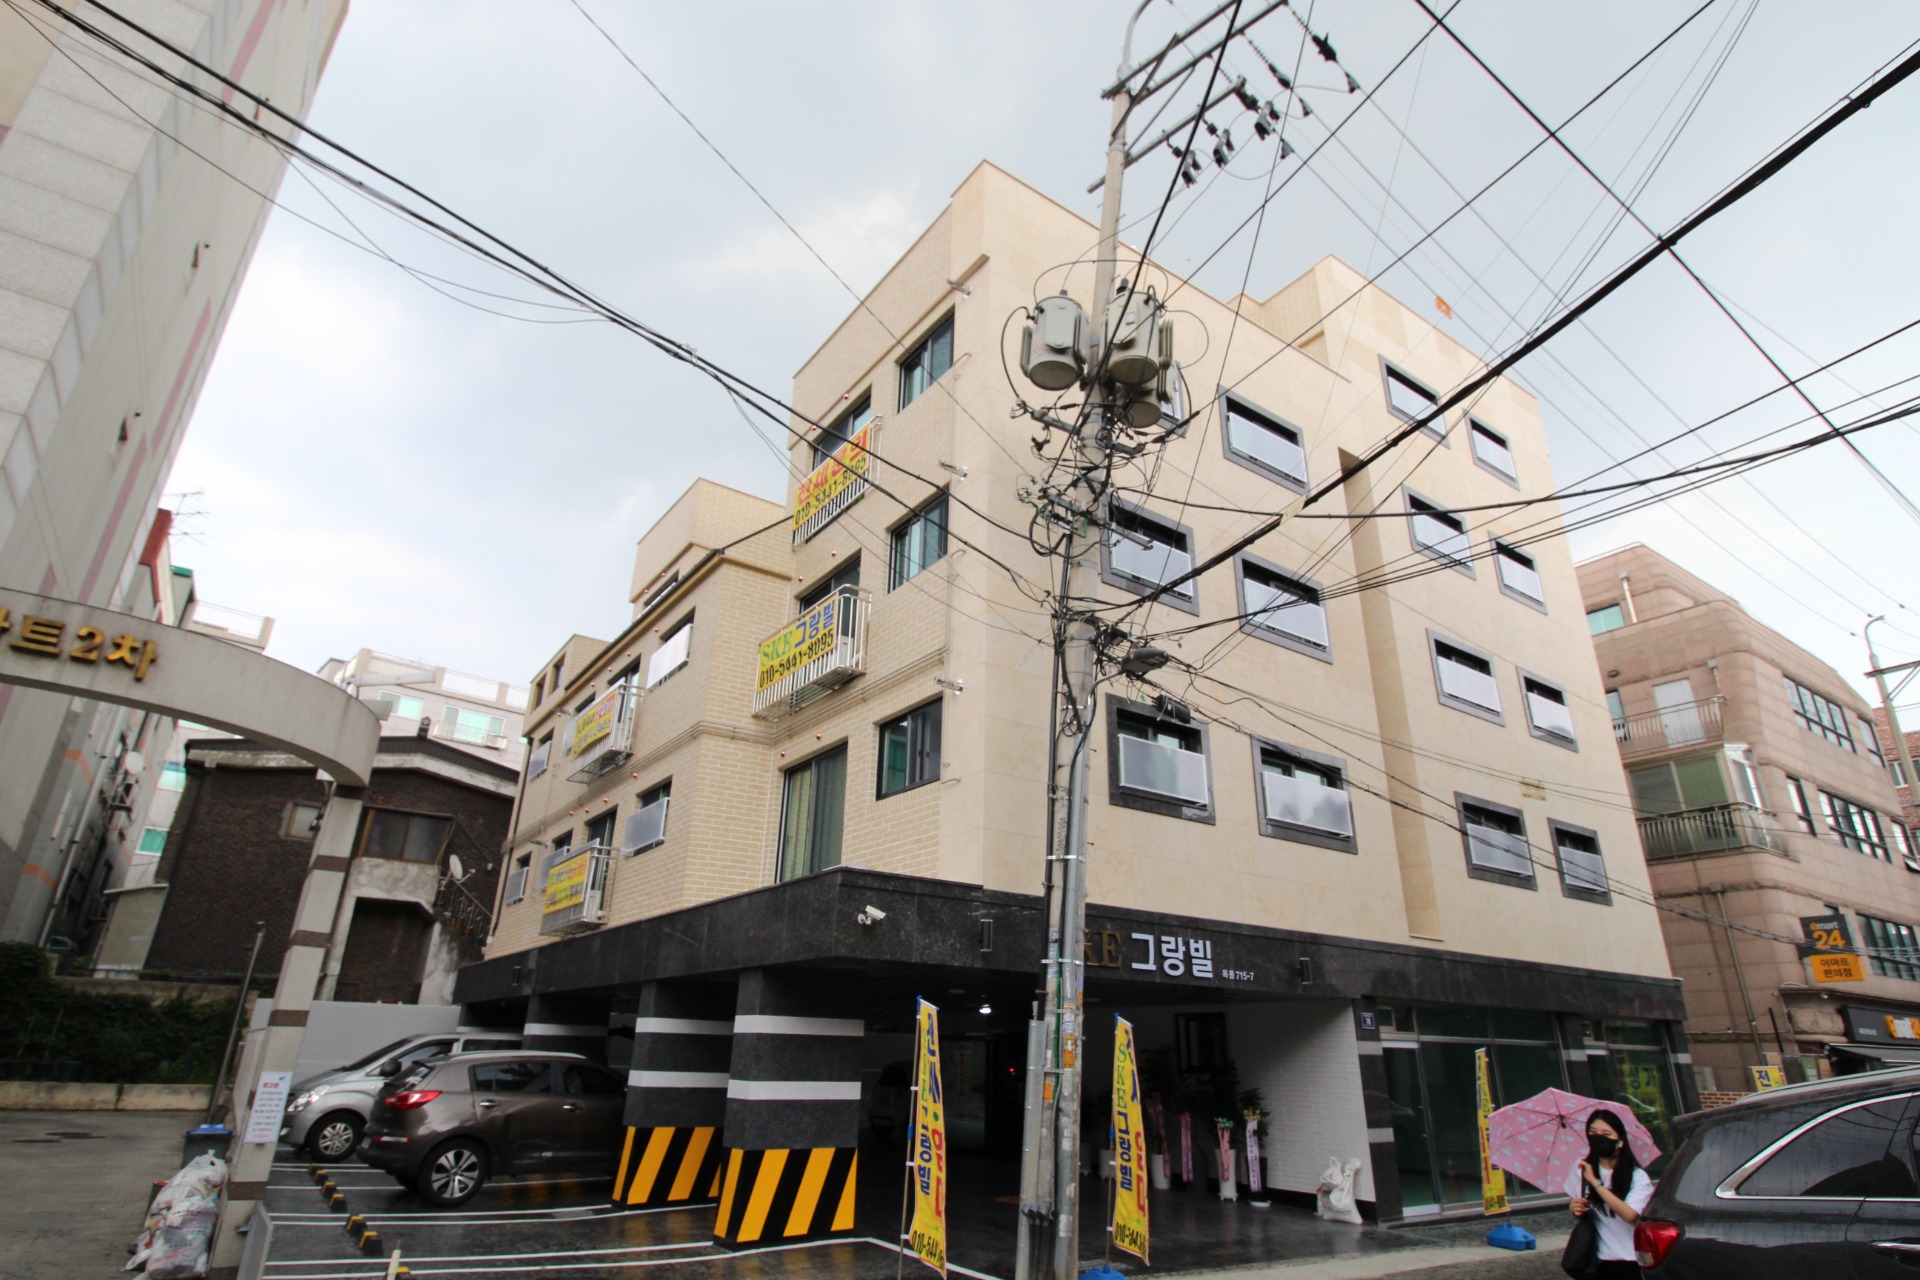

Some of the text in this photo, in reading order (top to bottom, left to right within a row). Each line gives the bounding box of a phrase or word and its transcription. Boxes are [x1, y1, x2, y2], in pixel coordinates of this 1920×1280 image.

[795, 454, 866, 525] 010-5441-8095
[795, 599, 836, 649] 그랑빌
[759, 627, 834, 688] 010-5441-8095
[1131, 932, 1213, 978] 그랑빌
[1812, 929, 1846, 950] 24
[1820, 958, 1850, 967] 이마트
[1823, 968, 1853, 978] 편의점
[1117, 1110, 1133, 1192] 그랑빌
